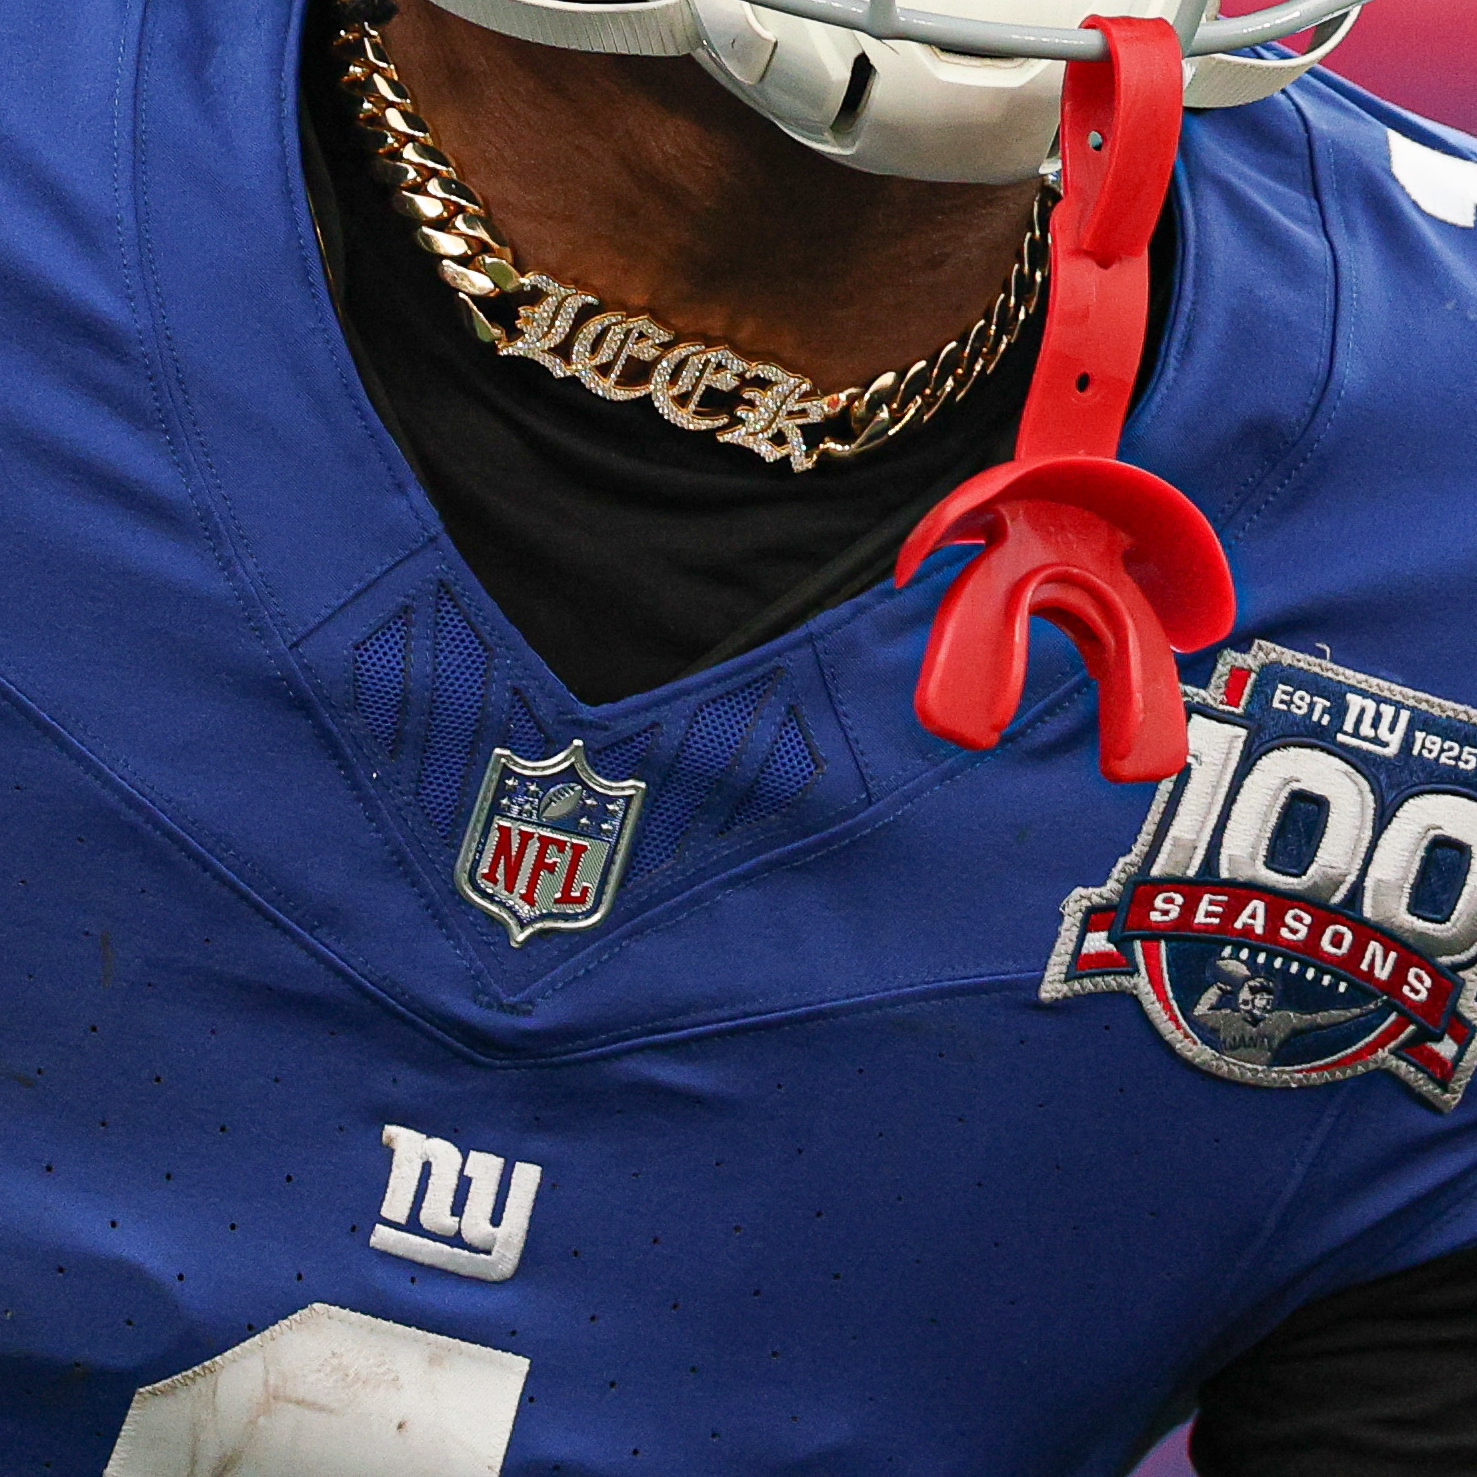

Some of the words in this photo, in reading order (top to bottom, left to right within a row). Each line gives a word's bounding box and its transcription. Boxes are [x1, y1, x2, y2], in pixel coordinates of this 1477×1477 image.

[1272, 683, 1331, 726] EST.
[480, 823, 591, 908] NFL
[1148, 890, 1433, 1004] SEASONS
